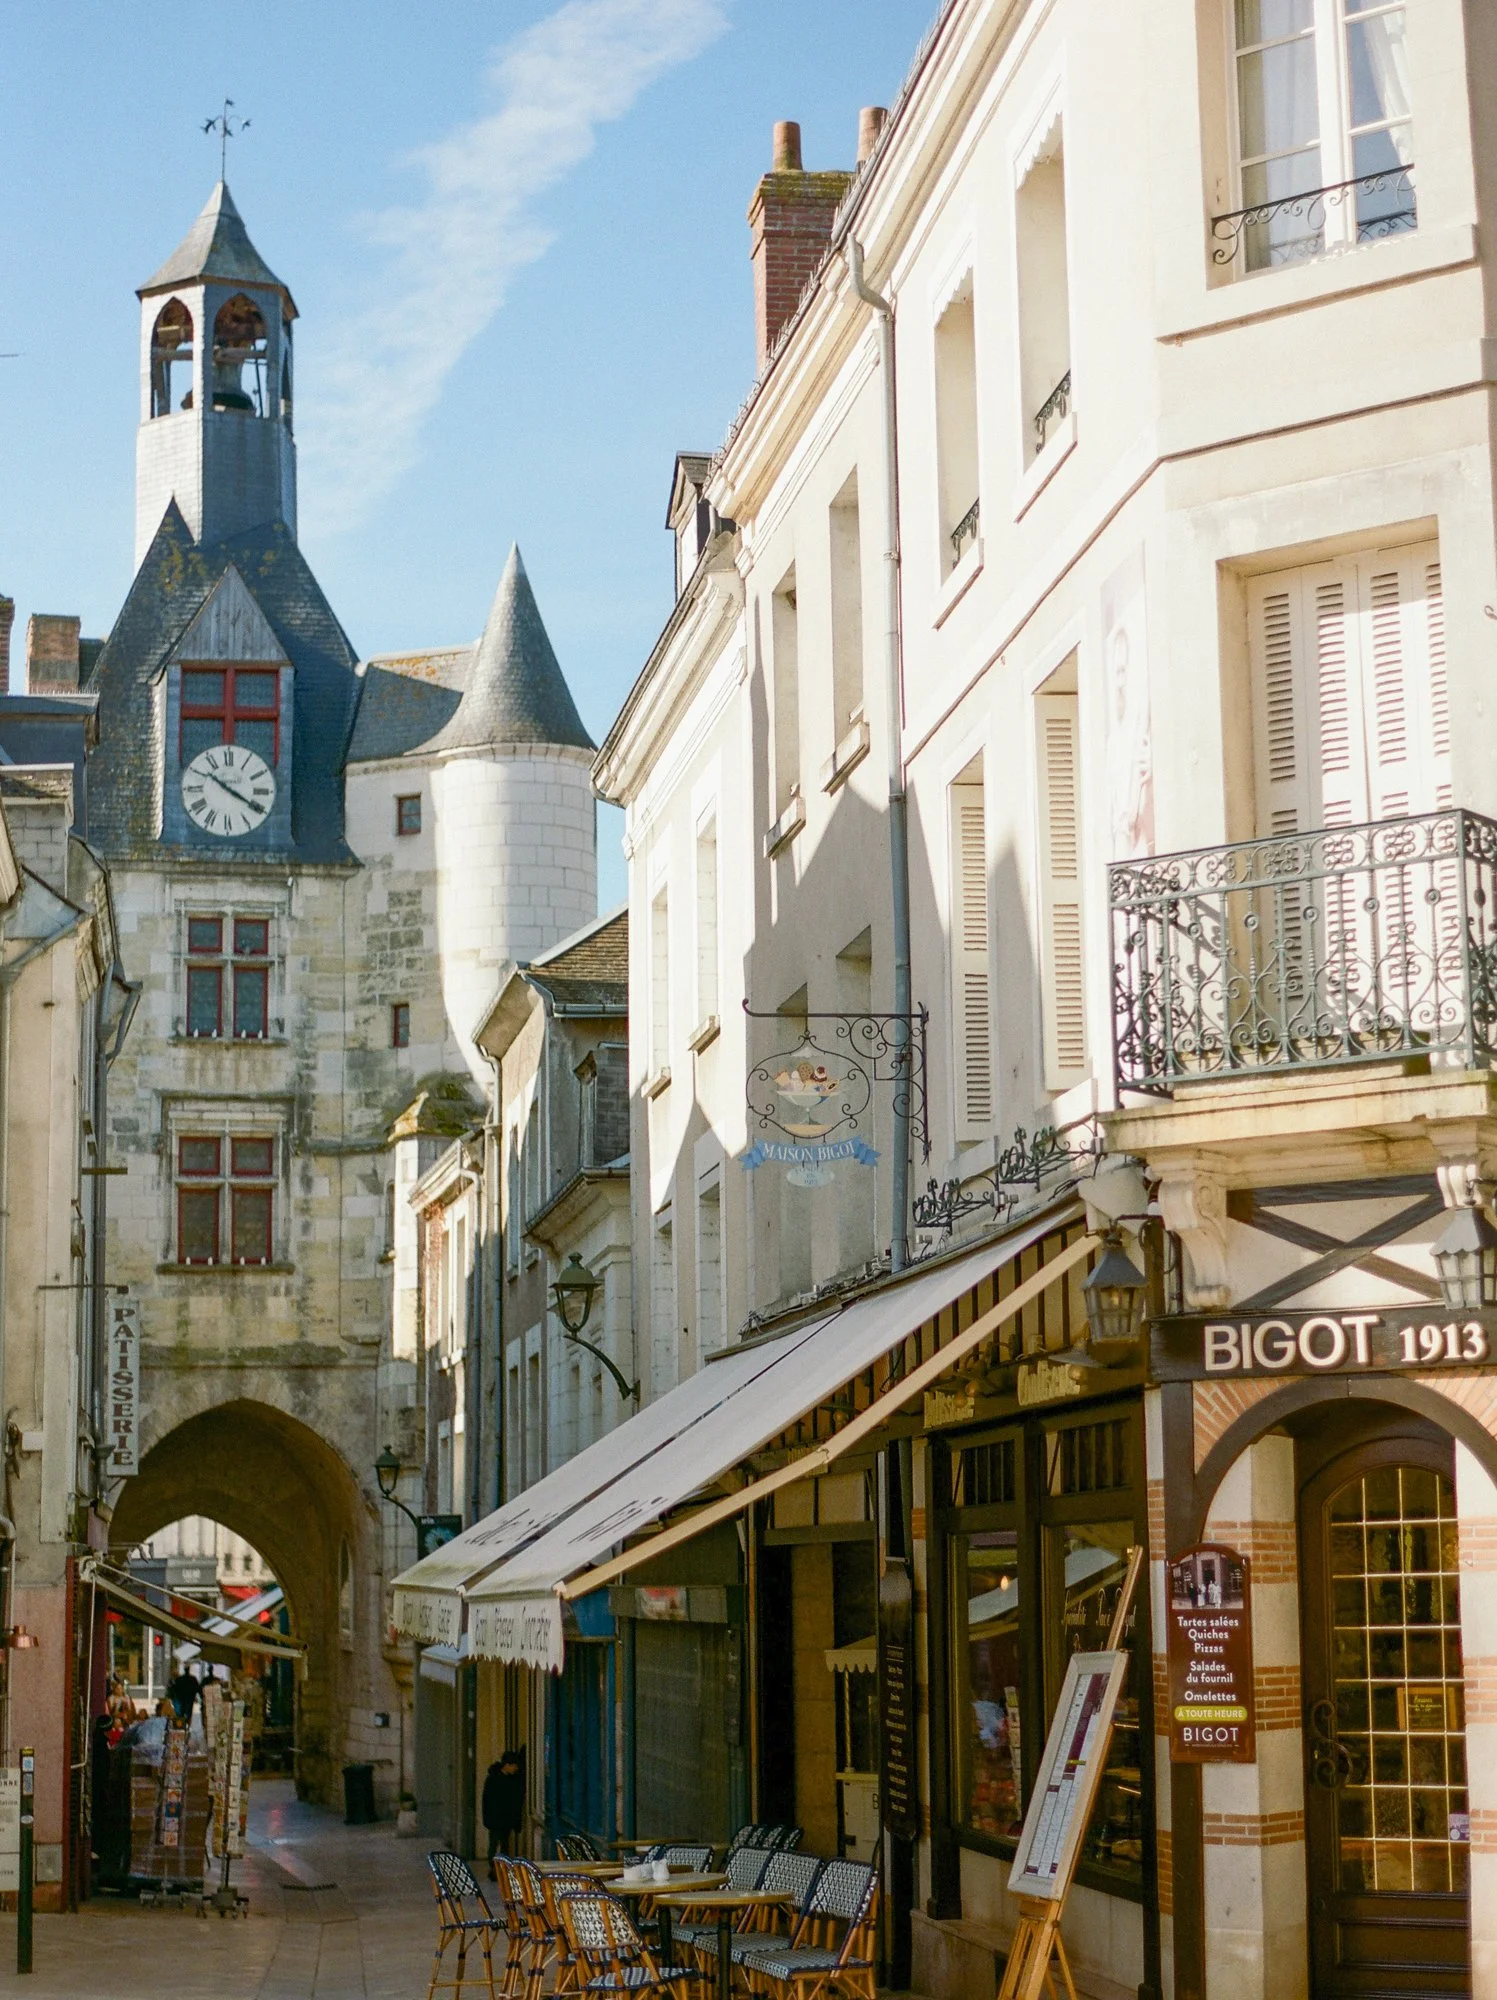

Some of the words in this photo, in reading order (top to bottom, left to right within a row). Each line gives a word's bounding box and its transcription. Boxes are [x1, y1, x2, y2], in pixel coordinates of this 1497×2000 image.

[763, 1143, 813, 1161] MAISON
[817, 1140, 855, 1161] BIGOT
[1204, 1315, 1380, 1372] BIGOT
[1400, 1322, 1487, 1362] 1913
[112, 1307, 136, 1466] PATISSERIE
[1177, 1616, 1207, 1627] Tartes
[1210, 1616, 1239, 1627] salées
[1188, 1629, 1229, 1640] Quiches
[1194, 1642, 1224, 1653] Pizzas
[1190, 1661, 1226, 1672] Salades
[1186, 1673, 1198, 1683] du
[1200, 1672, 1233, 1683] fournil
[1184, 1691, 1237, 1702] Omelettes
[1186, 1709, 1212, 1718] TOUTE
[1214, 1709, 1243, 1718] HEURE
[1183, 1727, 1239, 1742] BIGOT
